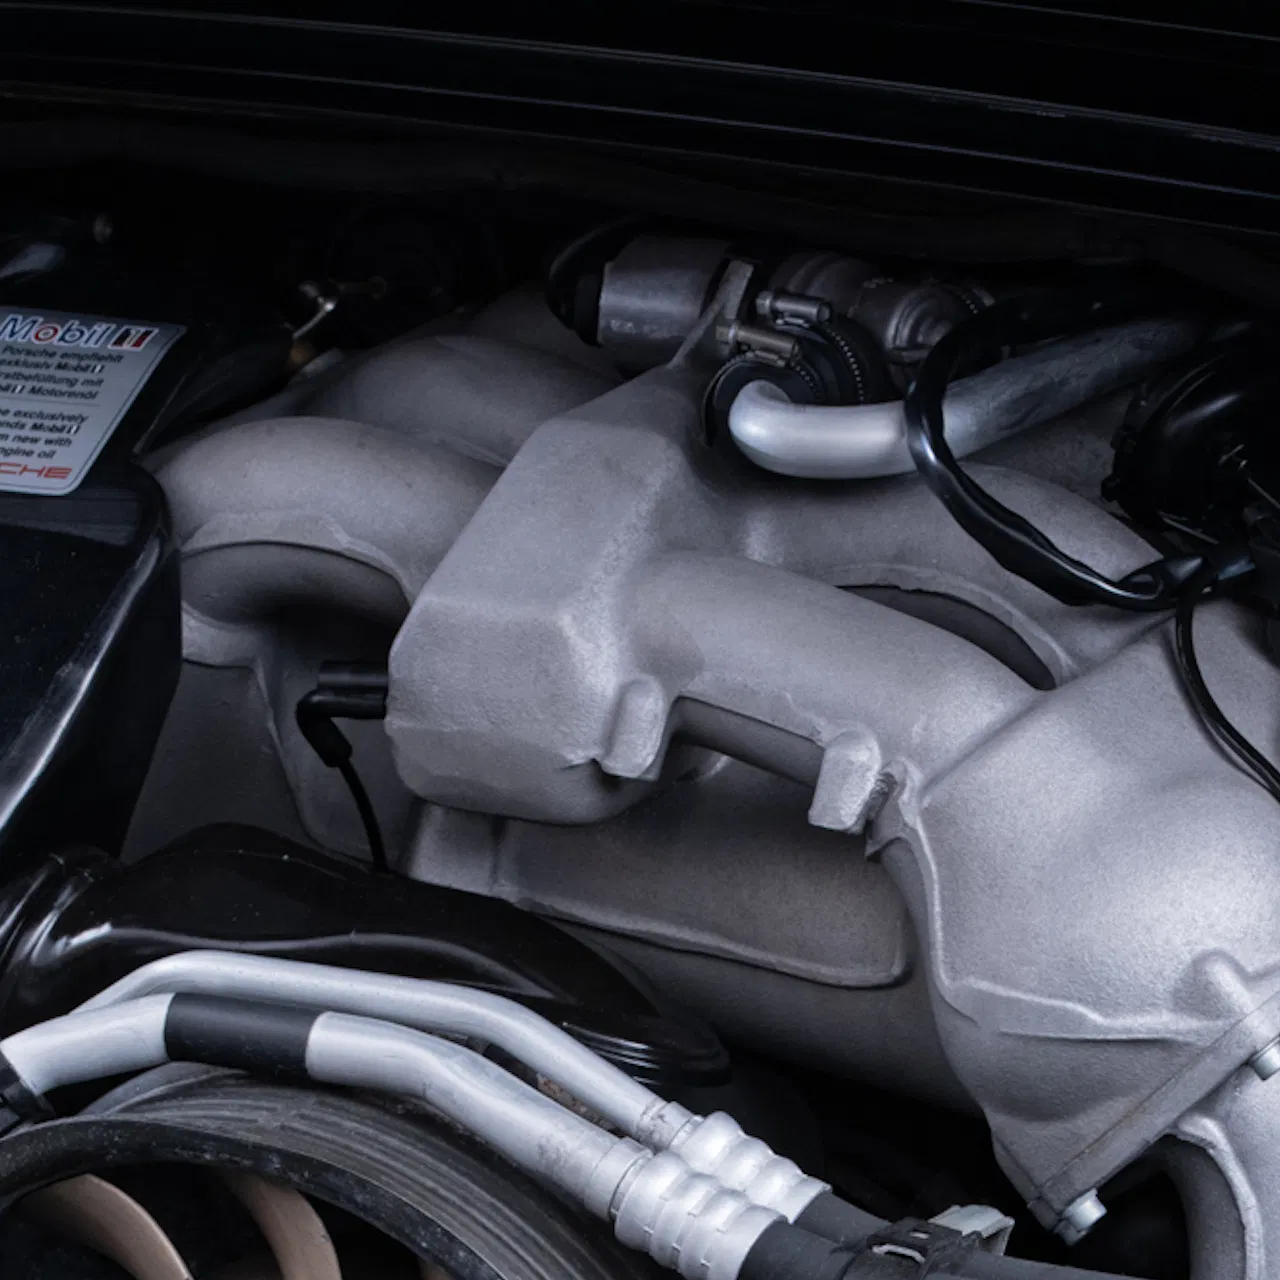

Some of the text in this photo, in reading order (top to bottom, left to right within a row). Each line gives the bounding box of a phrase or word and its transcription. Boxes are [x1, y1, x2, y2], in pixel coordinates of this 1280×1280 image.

[1, 346, 124, 364] Porsche empfiehlt
[81, 378, 104, 387] mit
[29, 386, 99, 400] Motorenöl
[13, 409, 89, 424] exclusively
[13, 435, 41, 445] new
[44, 436, 73, 447] with
[37, 450, 56, 459] oil
